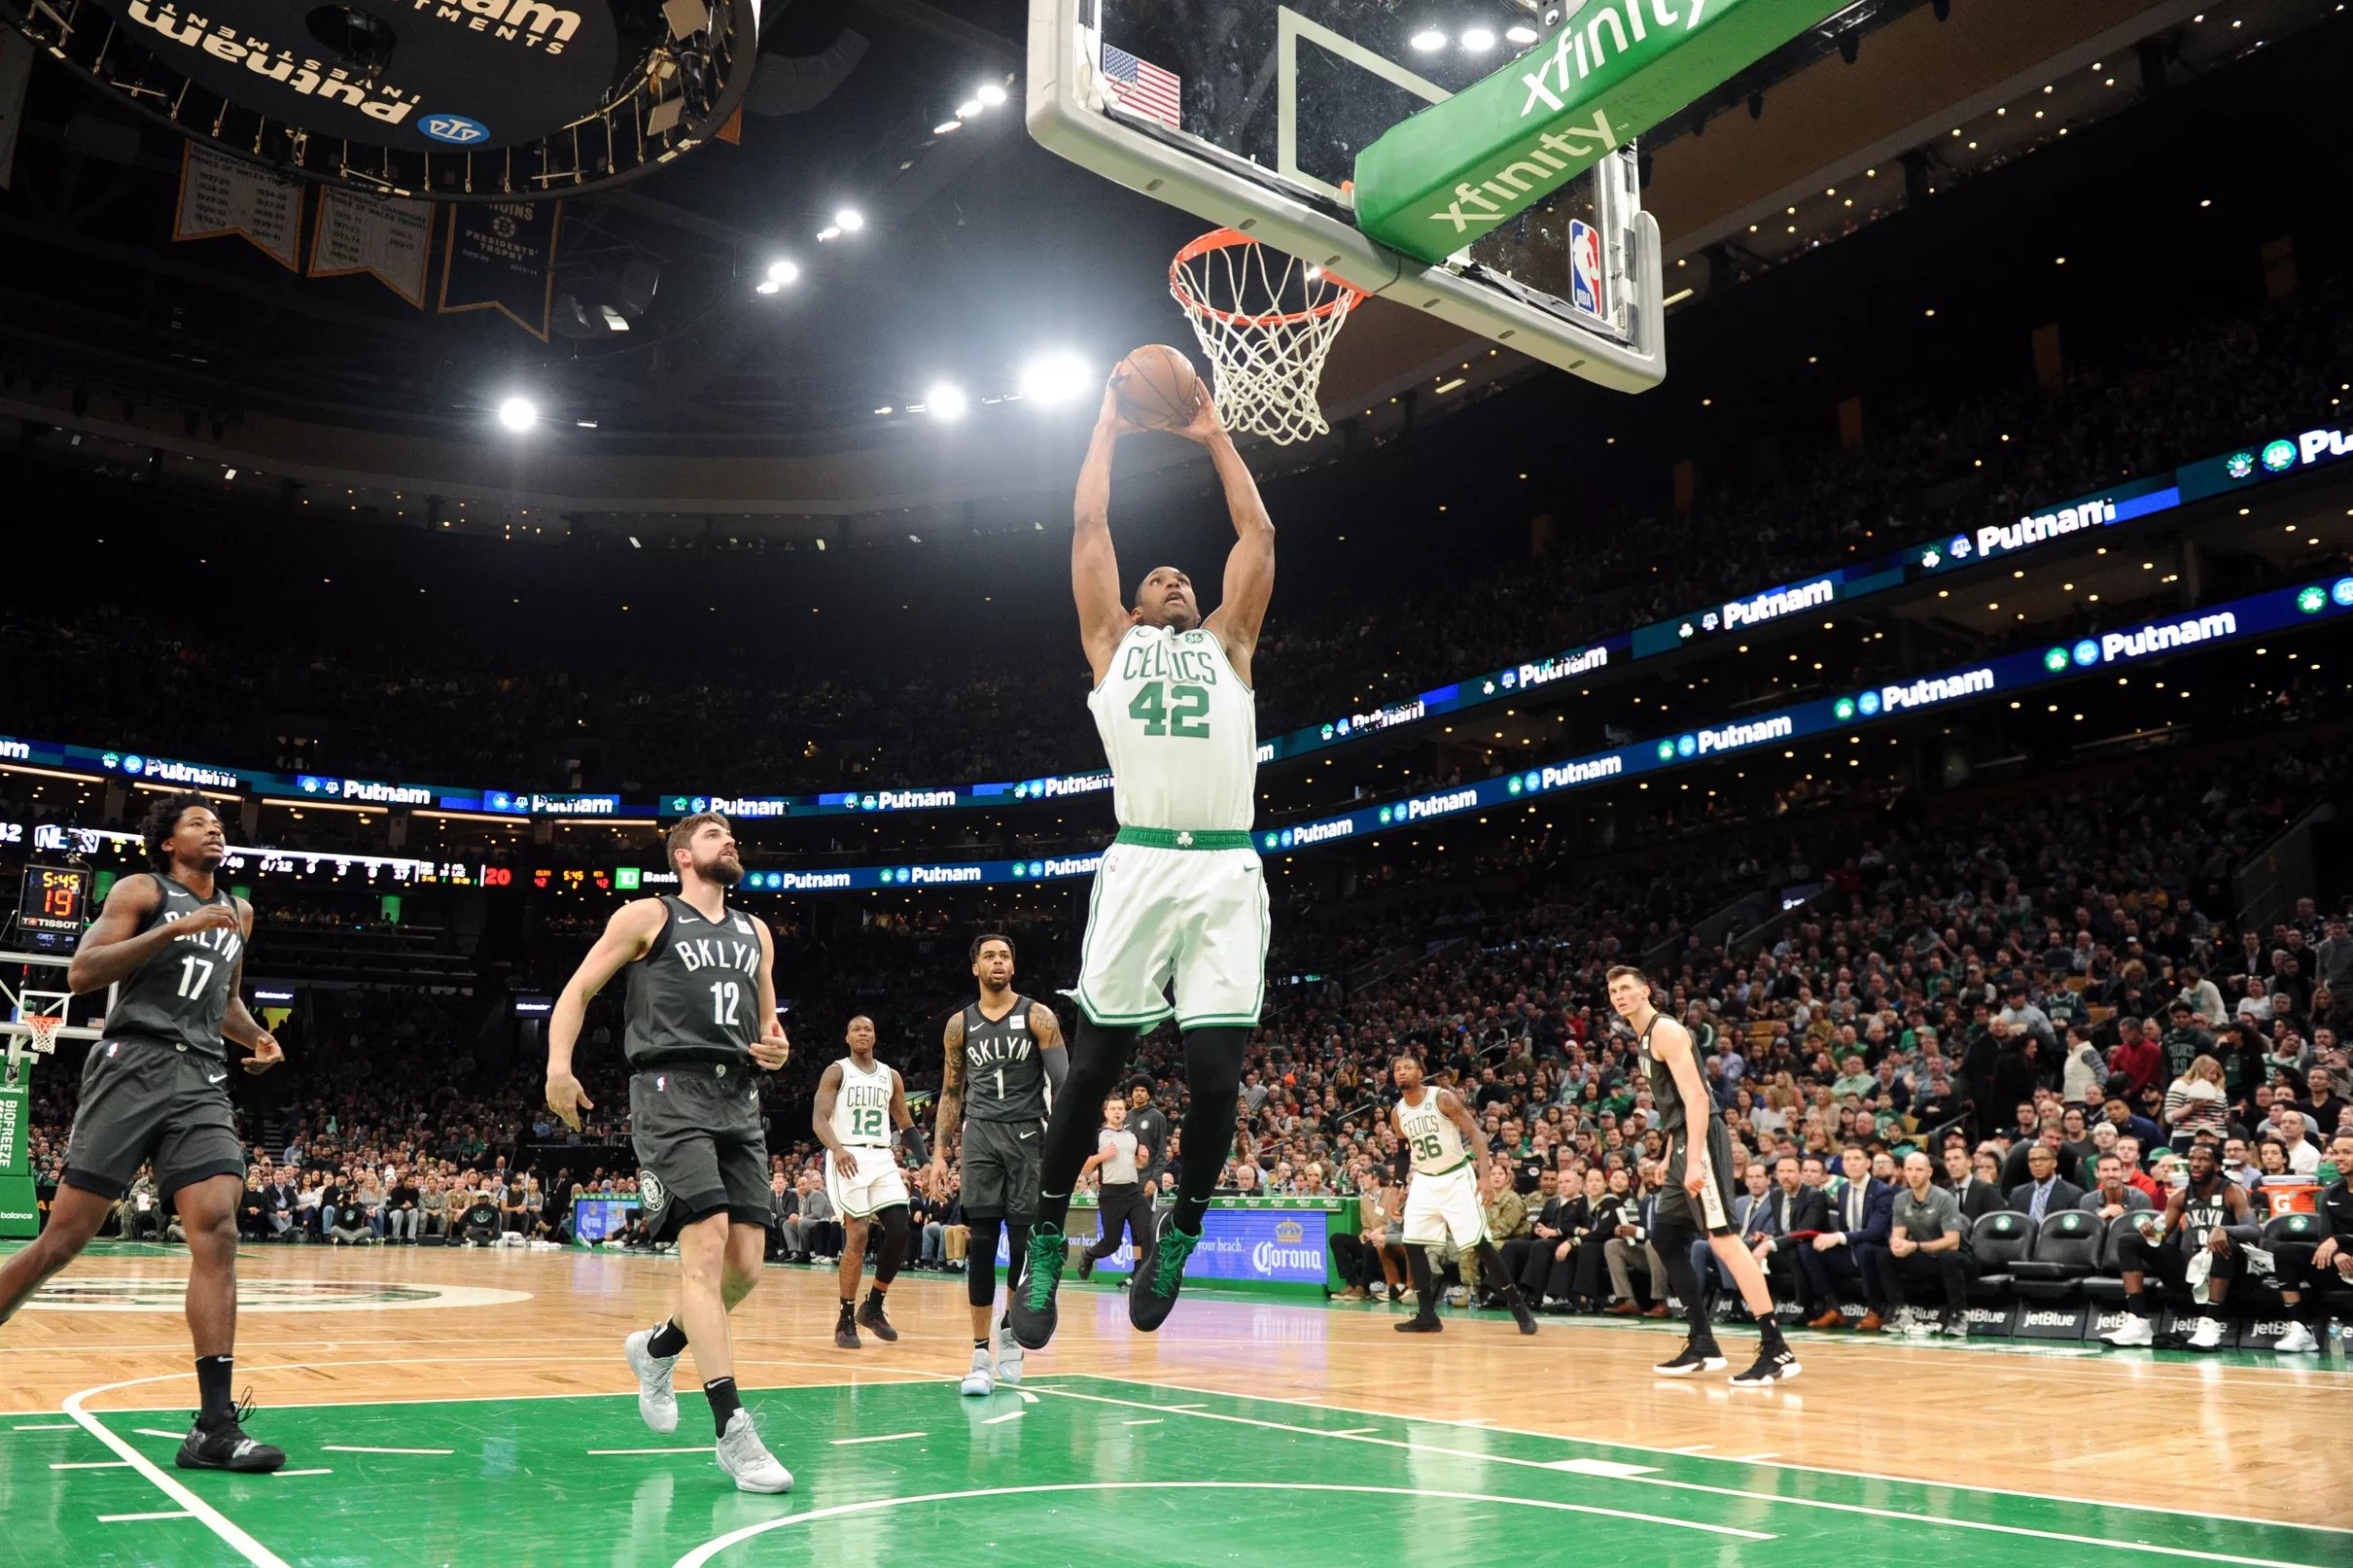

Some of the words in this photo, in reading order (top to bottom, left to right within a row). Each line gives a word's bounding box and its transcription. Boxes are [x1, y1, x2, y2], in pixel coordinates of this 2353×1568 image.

[127, 0, 416, 124] Putnam
[1428, 109, 1617, 233] xfinity
[480, 242, 523, 261] TROPHY
[1977, 497, 2116, 557] Putnam
[1723, 579, 1834, 630] Putnam
[2101, 611, 2236, 662] Putnam
[1519, 646, 1607, 688] Putnam
[1881, 668, 1994, 712] Putnam
[1128, 681, 1210, 739] 42
[1698, 716, 1792, 754] Putnam
[1542, 755, 1622, 789] Putnam
[343, 780, 431, 804] Putnam
[878, 790, 956, 809] Putnam
[1408, 789, 1477, 819] Putnam
[1293, 819, 1353, 846] Putnam
[43, 871, 79, 890] 5:45
[485, 868, 510, 885] 20
[564, 871, 583, 881] 5:45
[619, 871, 637, 885] TD
[643, 871, 678, 883] Bank
[784, 873, 850, 889] Putnam
[912, 866, 981, 884] Putnam
[45, 889, 74, 917] 19
[675, 938, 759, 978] BKLYN
[177, 955, 214, 1000] 17
[710, 981, 739, 1026] 12
[966, 1036, 1032, 1067] BKLYN
[847, 1085, 890, 1111] CELTICS
[994, 1068, 1004, 1099] 1
[3, 1099, 18, 1168] BIOFREEZE
[852, 1108, 882, 1136] 12
[1404, 1115, 1439, 1138] CELTICS
[1412, 1135, 1443, 1162] 36
[2273, 1194, 2291, 1213] G
[1252, 1240, 1322, 1275] Corona
[1963, 1307, 2006, 1323] etBlue
[2022, 1309, 2077, 1328] jetBlue
